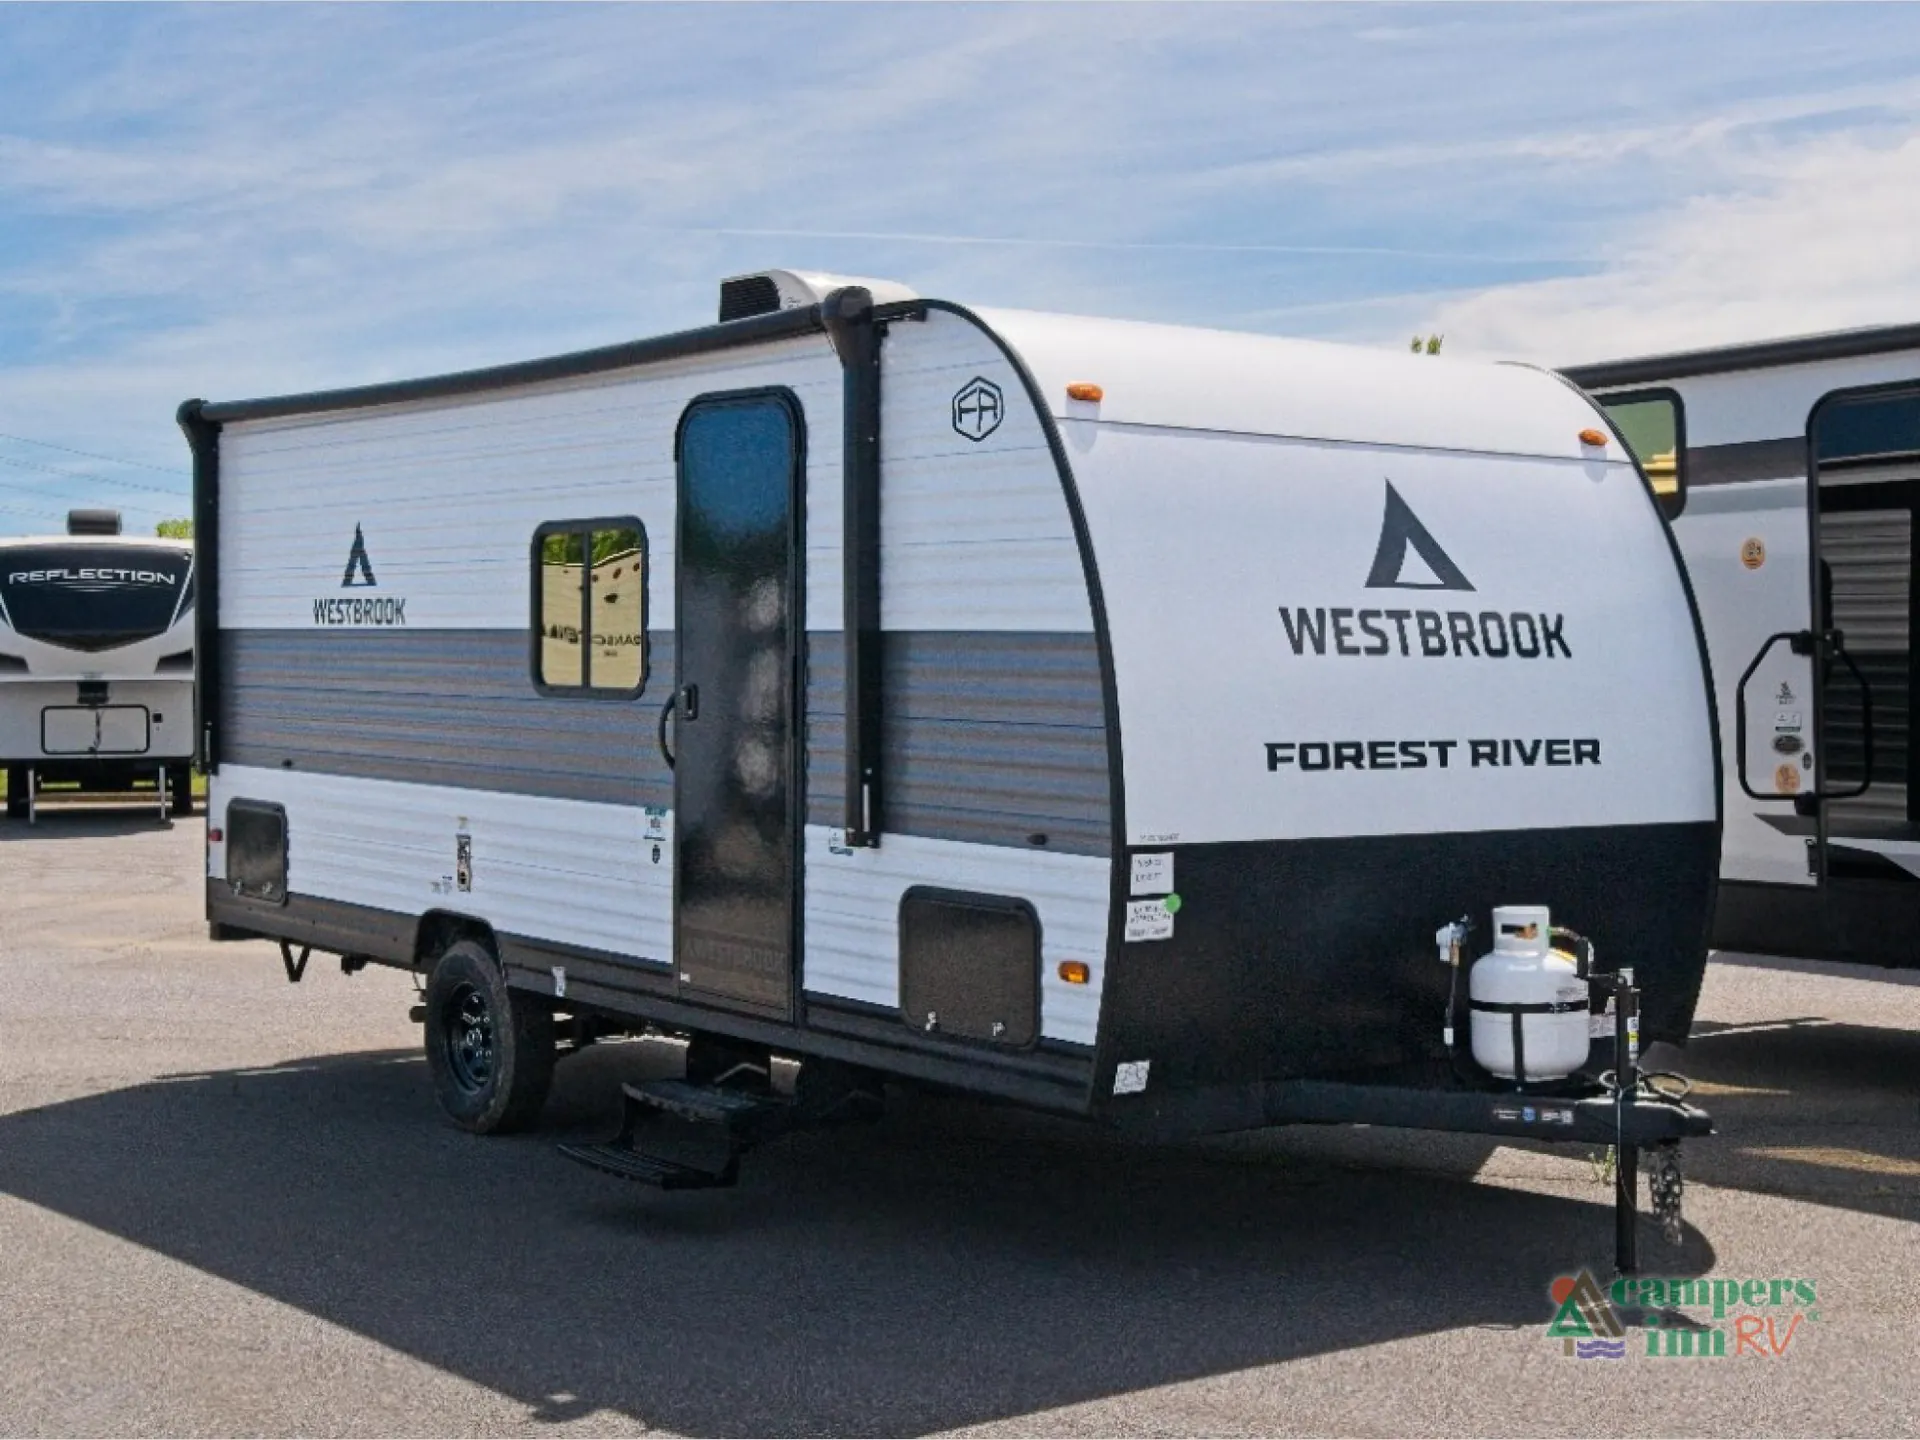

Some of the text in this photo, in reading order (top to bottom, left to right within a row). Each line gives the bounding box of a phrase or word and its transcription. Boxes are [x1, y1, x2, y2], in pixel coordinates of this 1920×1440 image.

[9, 568, 175, 585] REFLECTION
[313, 598, 406, 625] WESTBROOK
[1278, 606, 1572, 658] WESTBROOK
[1264, 738, 1602, 771] FOREST RIVER
